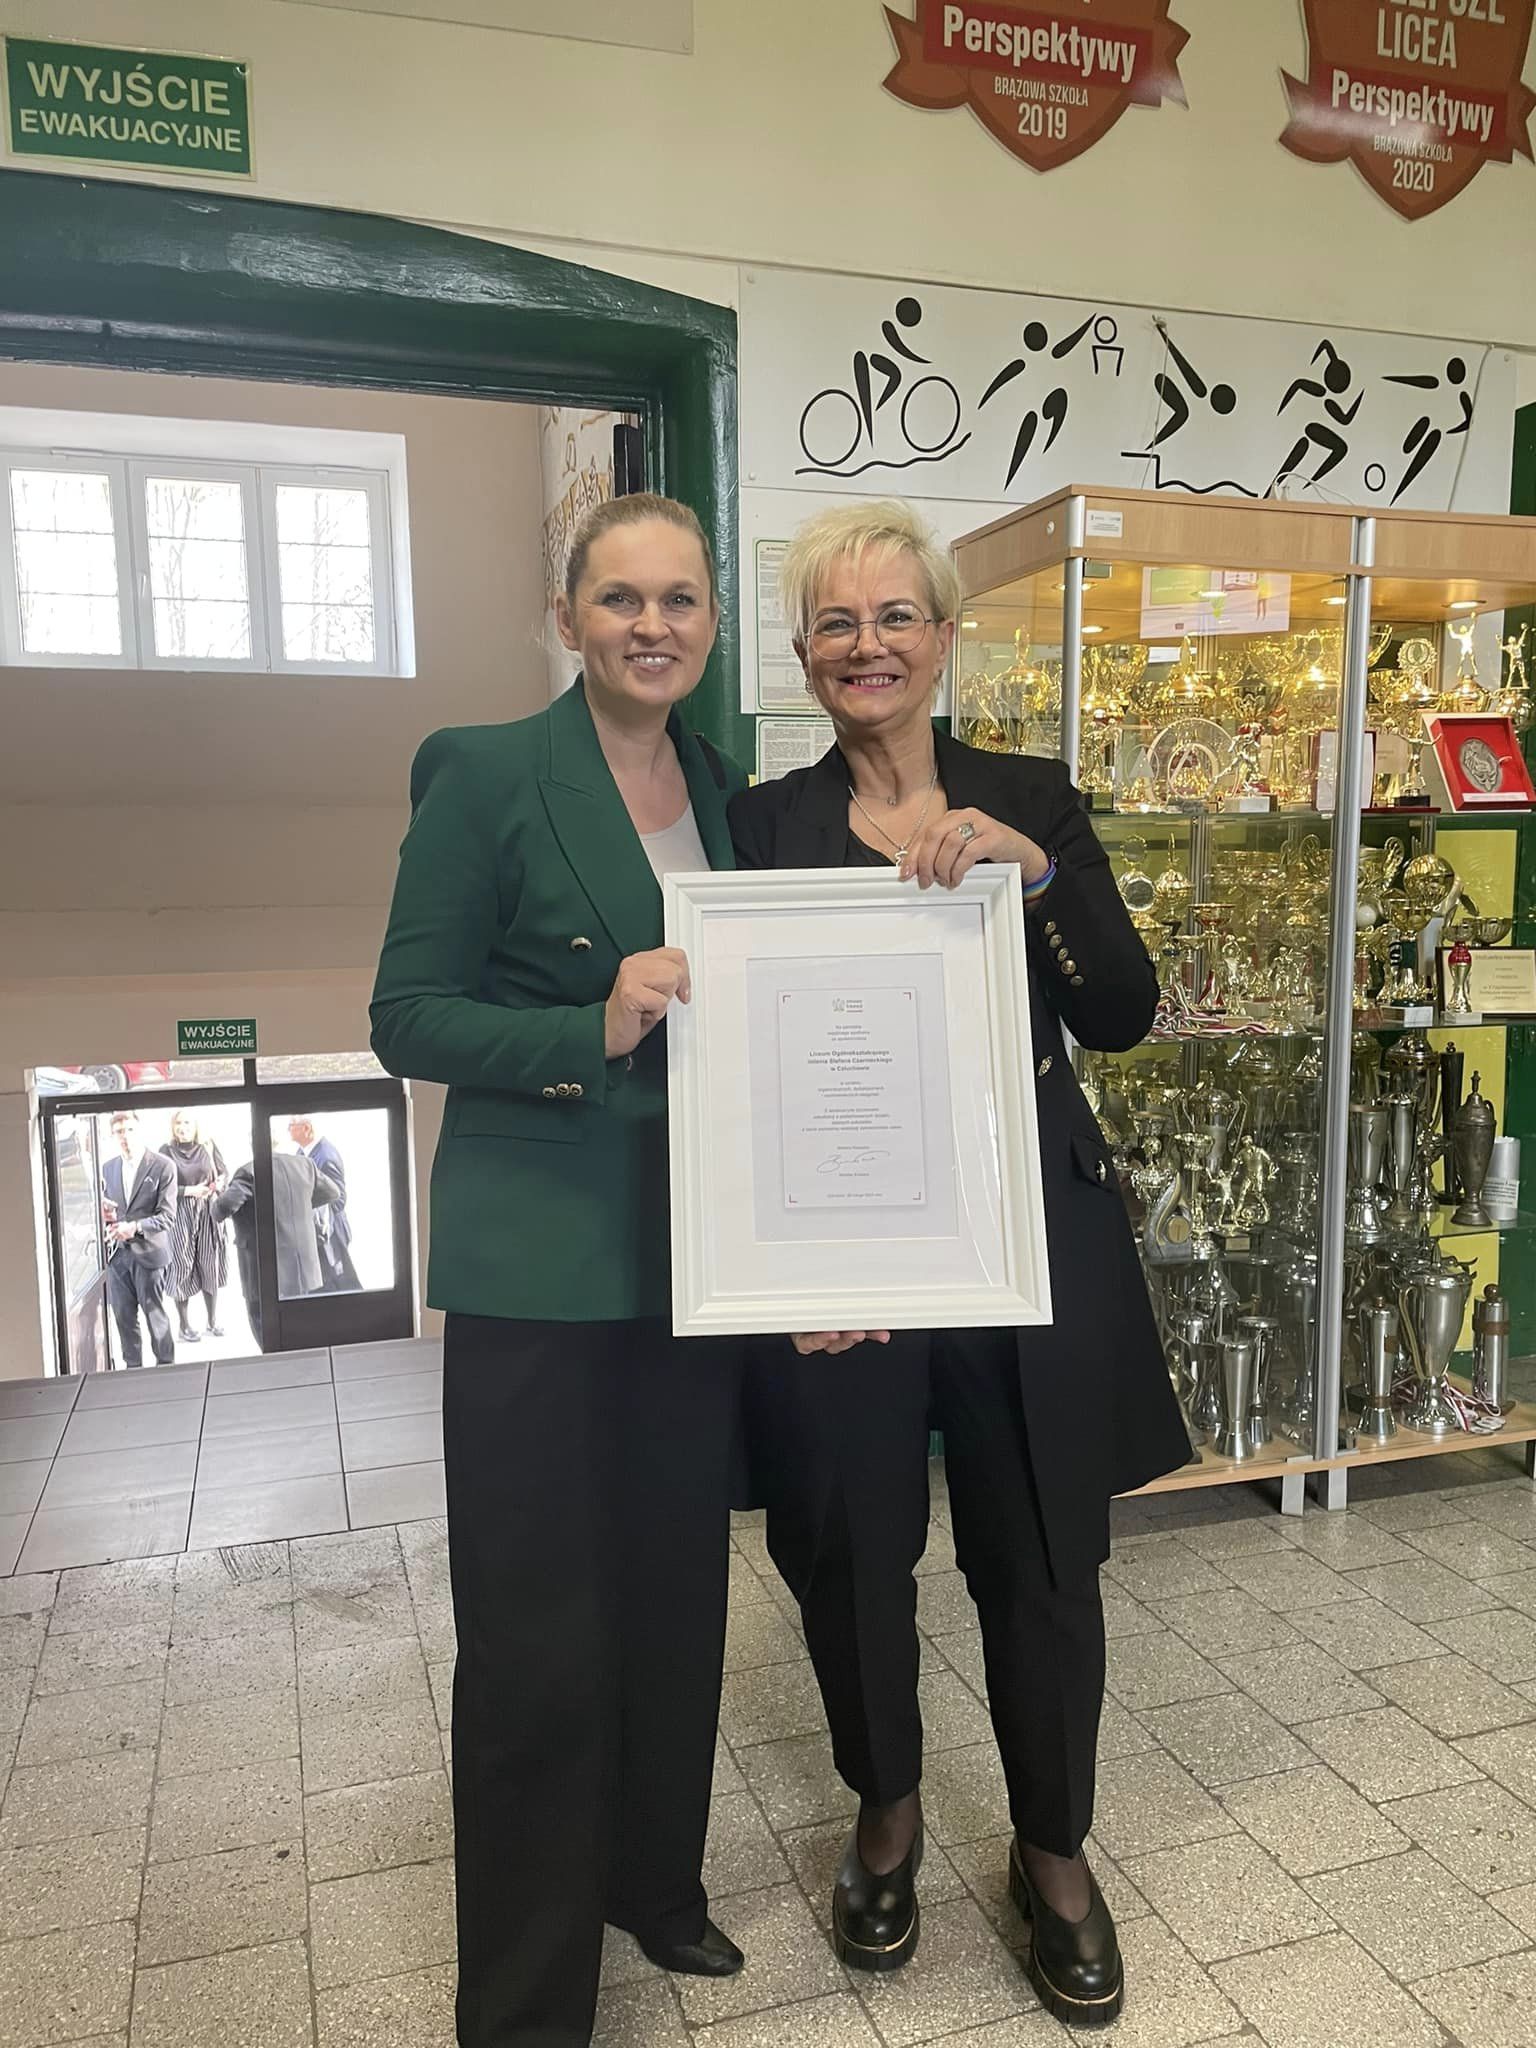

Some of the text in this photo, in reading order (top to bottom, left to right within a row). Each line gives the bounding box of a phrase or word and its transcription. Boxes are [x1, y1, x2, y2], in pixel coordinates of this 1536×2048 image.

[943, 4, 1137, 83] Perspektywy
[1377, 8, 1457, 69] LICEA
[27, 61, 231, 116] WYJŚCIE
[994, 76, 1089, 106] BRĄZOWA SZKOŁA
[1331, 69, 1494, 142] Perspektywy
[19, 109, 242, 152] EWAKUACYJNE
[1018, 102, 1067, 139] 2019
[1374, 135, 1453, 163] BRĄZOWA SZKOŁA
[1393, 158, 1434, 192] 2020
[181, 1040, 255, 1049] EWAKUACYJNE
[184, 1024, 251, 1038] WYJŚCIE
